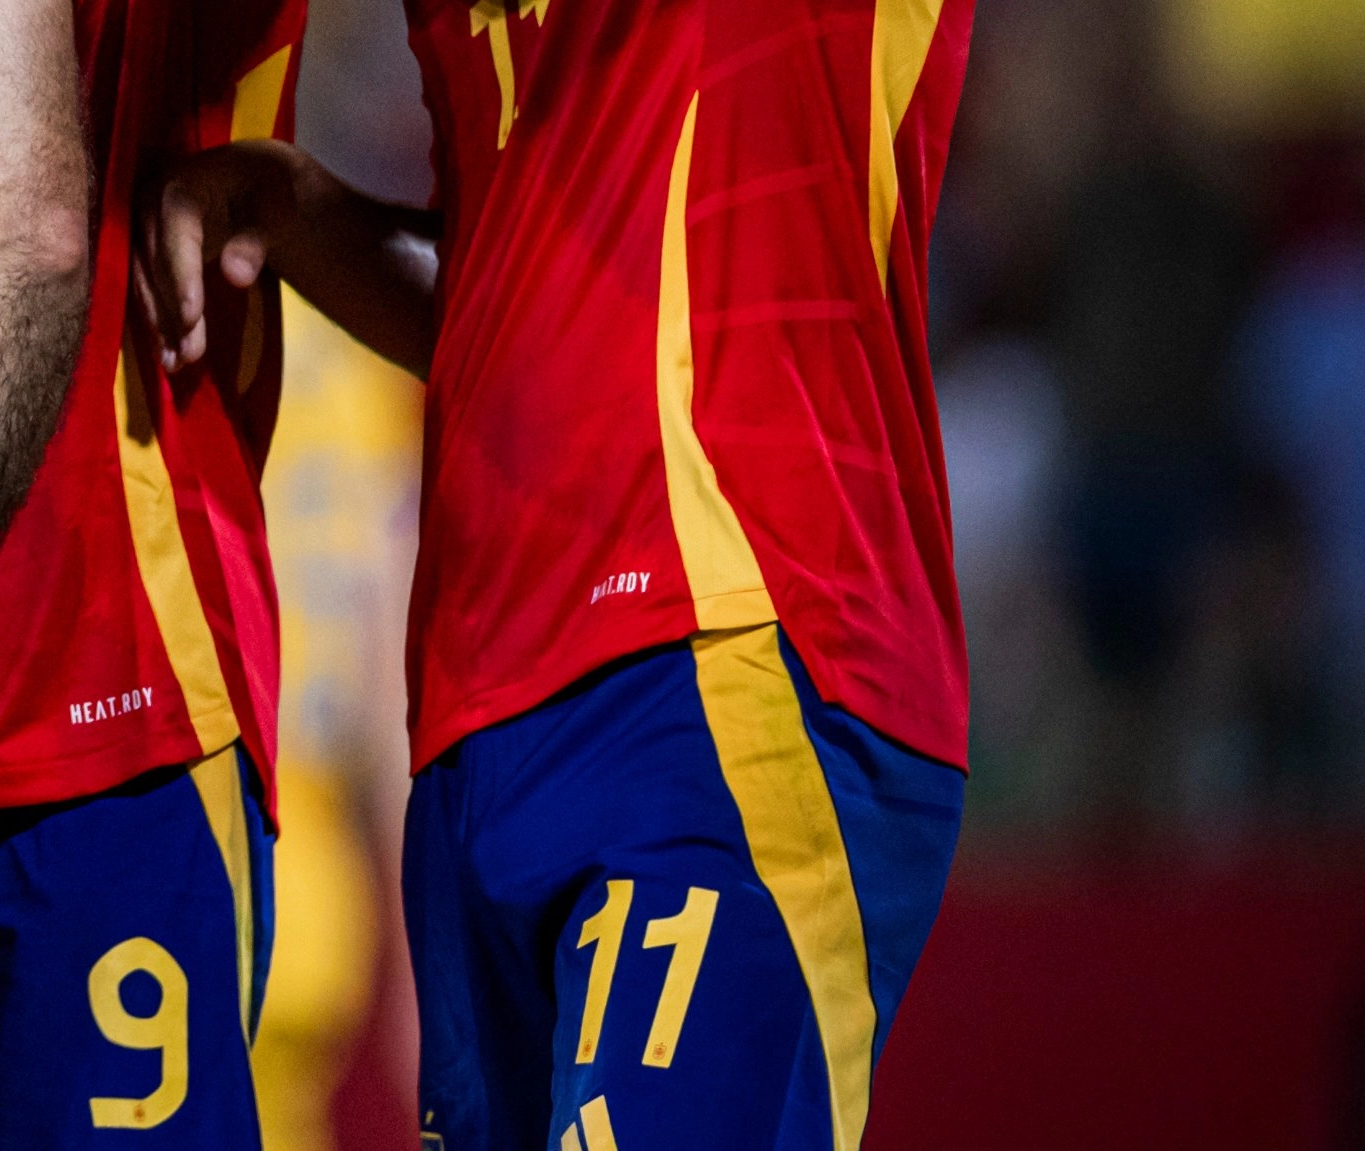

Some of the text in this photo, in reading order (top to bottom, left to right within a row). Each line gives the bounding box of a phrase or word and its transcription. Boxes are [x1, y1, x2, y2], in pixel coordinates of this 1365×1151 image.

[69, 686, 153, 725] HEAT.RDY
[87, 934, 190, 1130] 9
[576, 878, 721, 1070] 11
